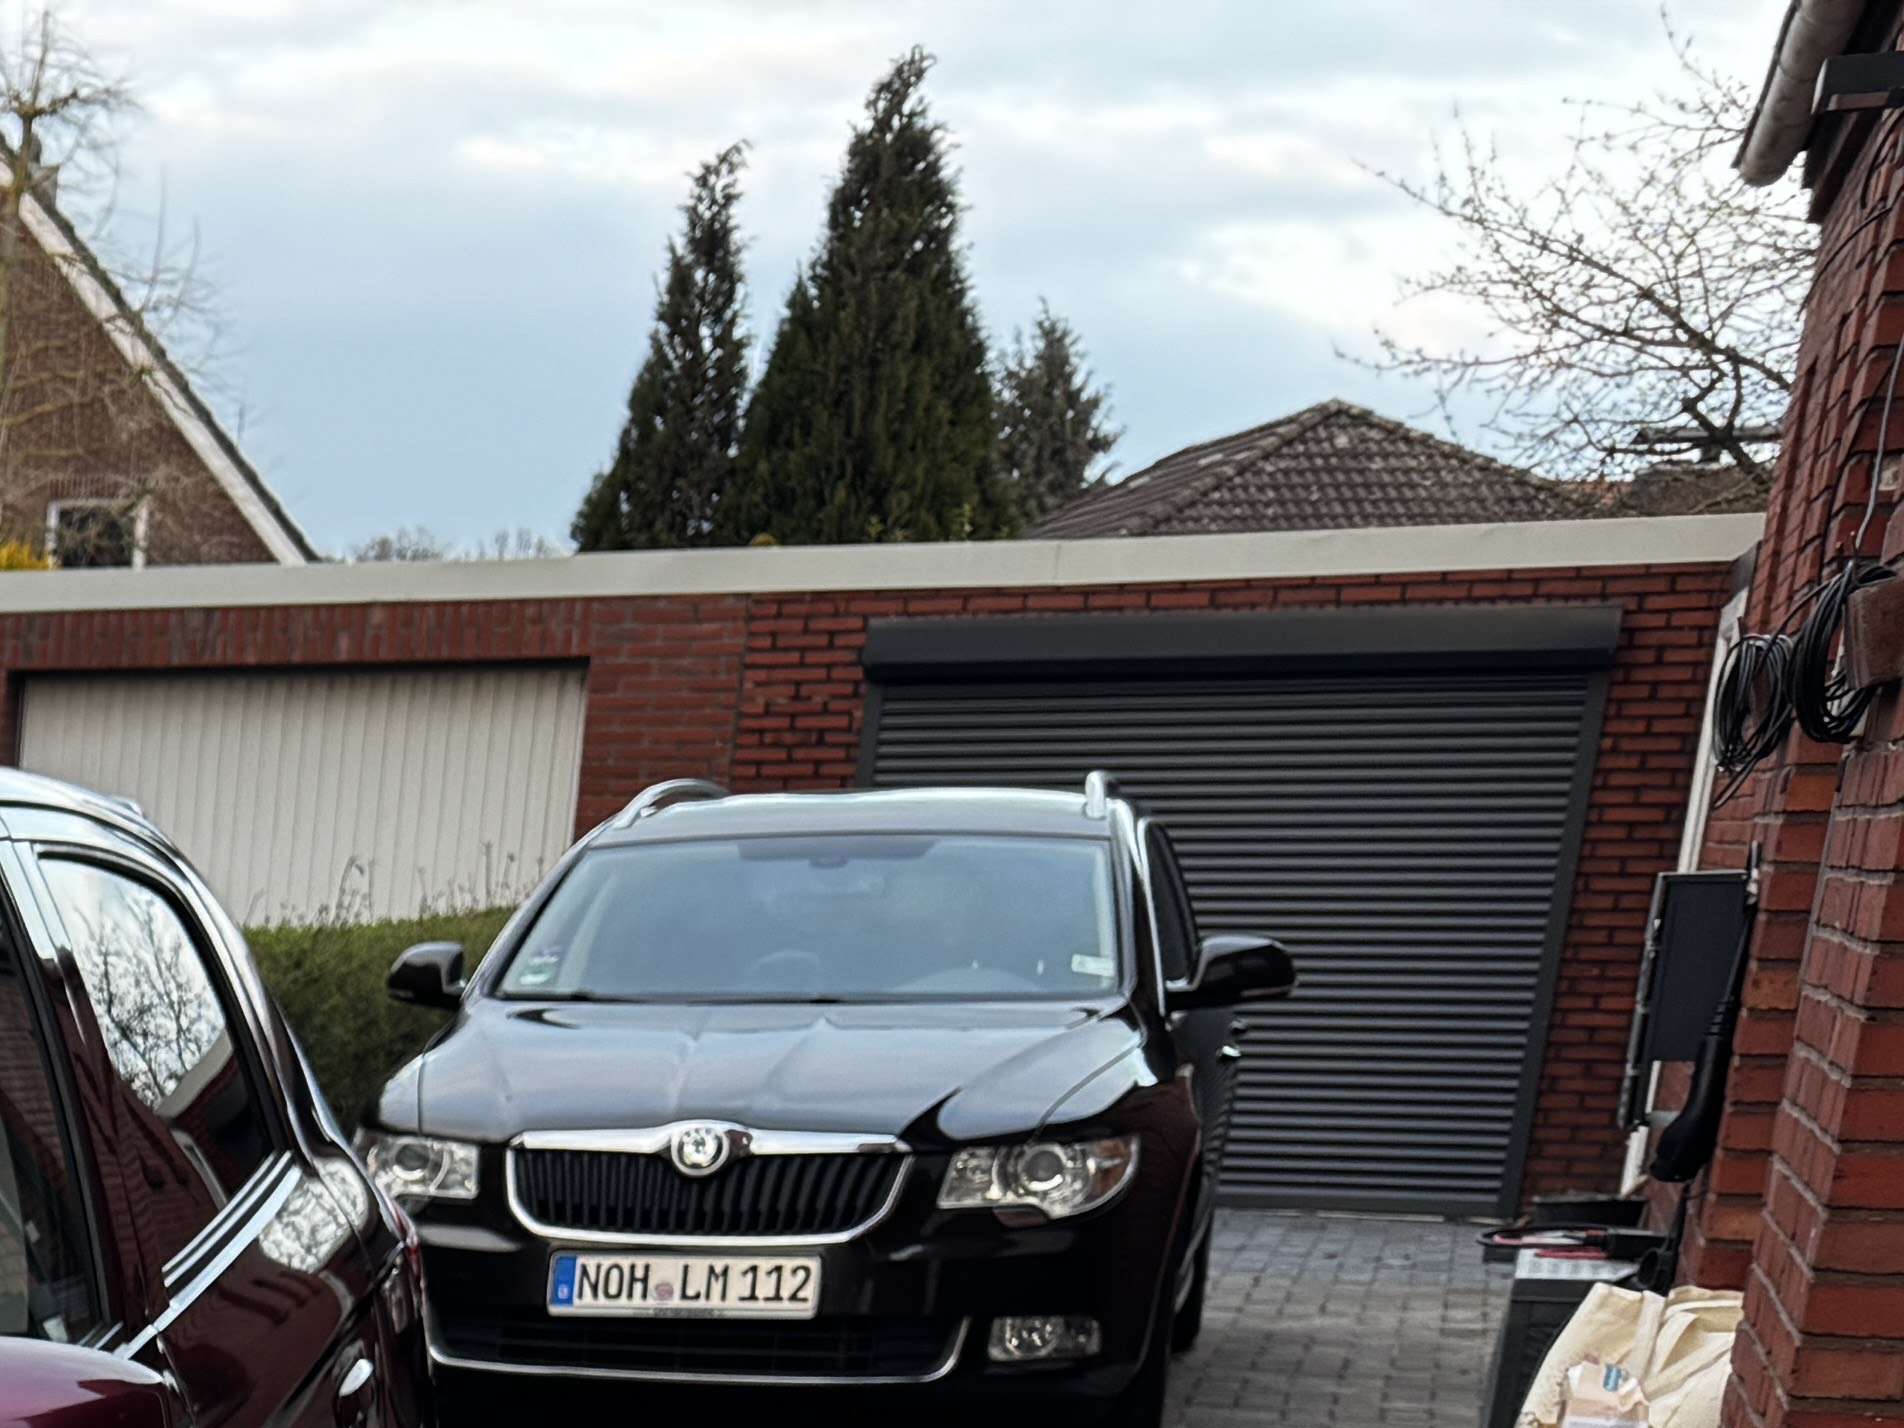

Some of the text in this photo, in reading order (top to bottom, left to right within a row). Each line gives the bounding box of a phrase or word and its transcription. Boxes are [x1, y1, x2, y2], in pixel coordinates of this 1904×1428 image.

[577, 1262, 651, 1301] NOH
[679, 1263, 730, 1303] LM
[737, 1264, 813, 1303] 112
